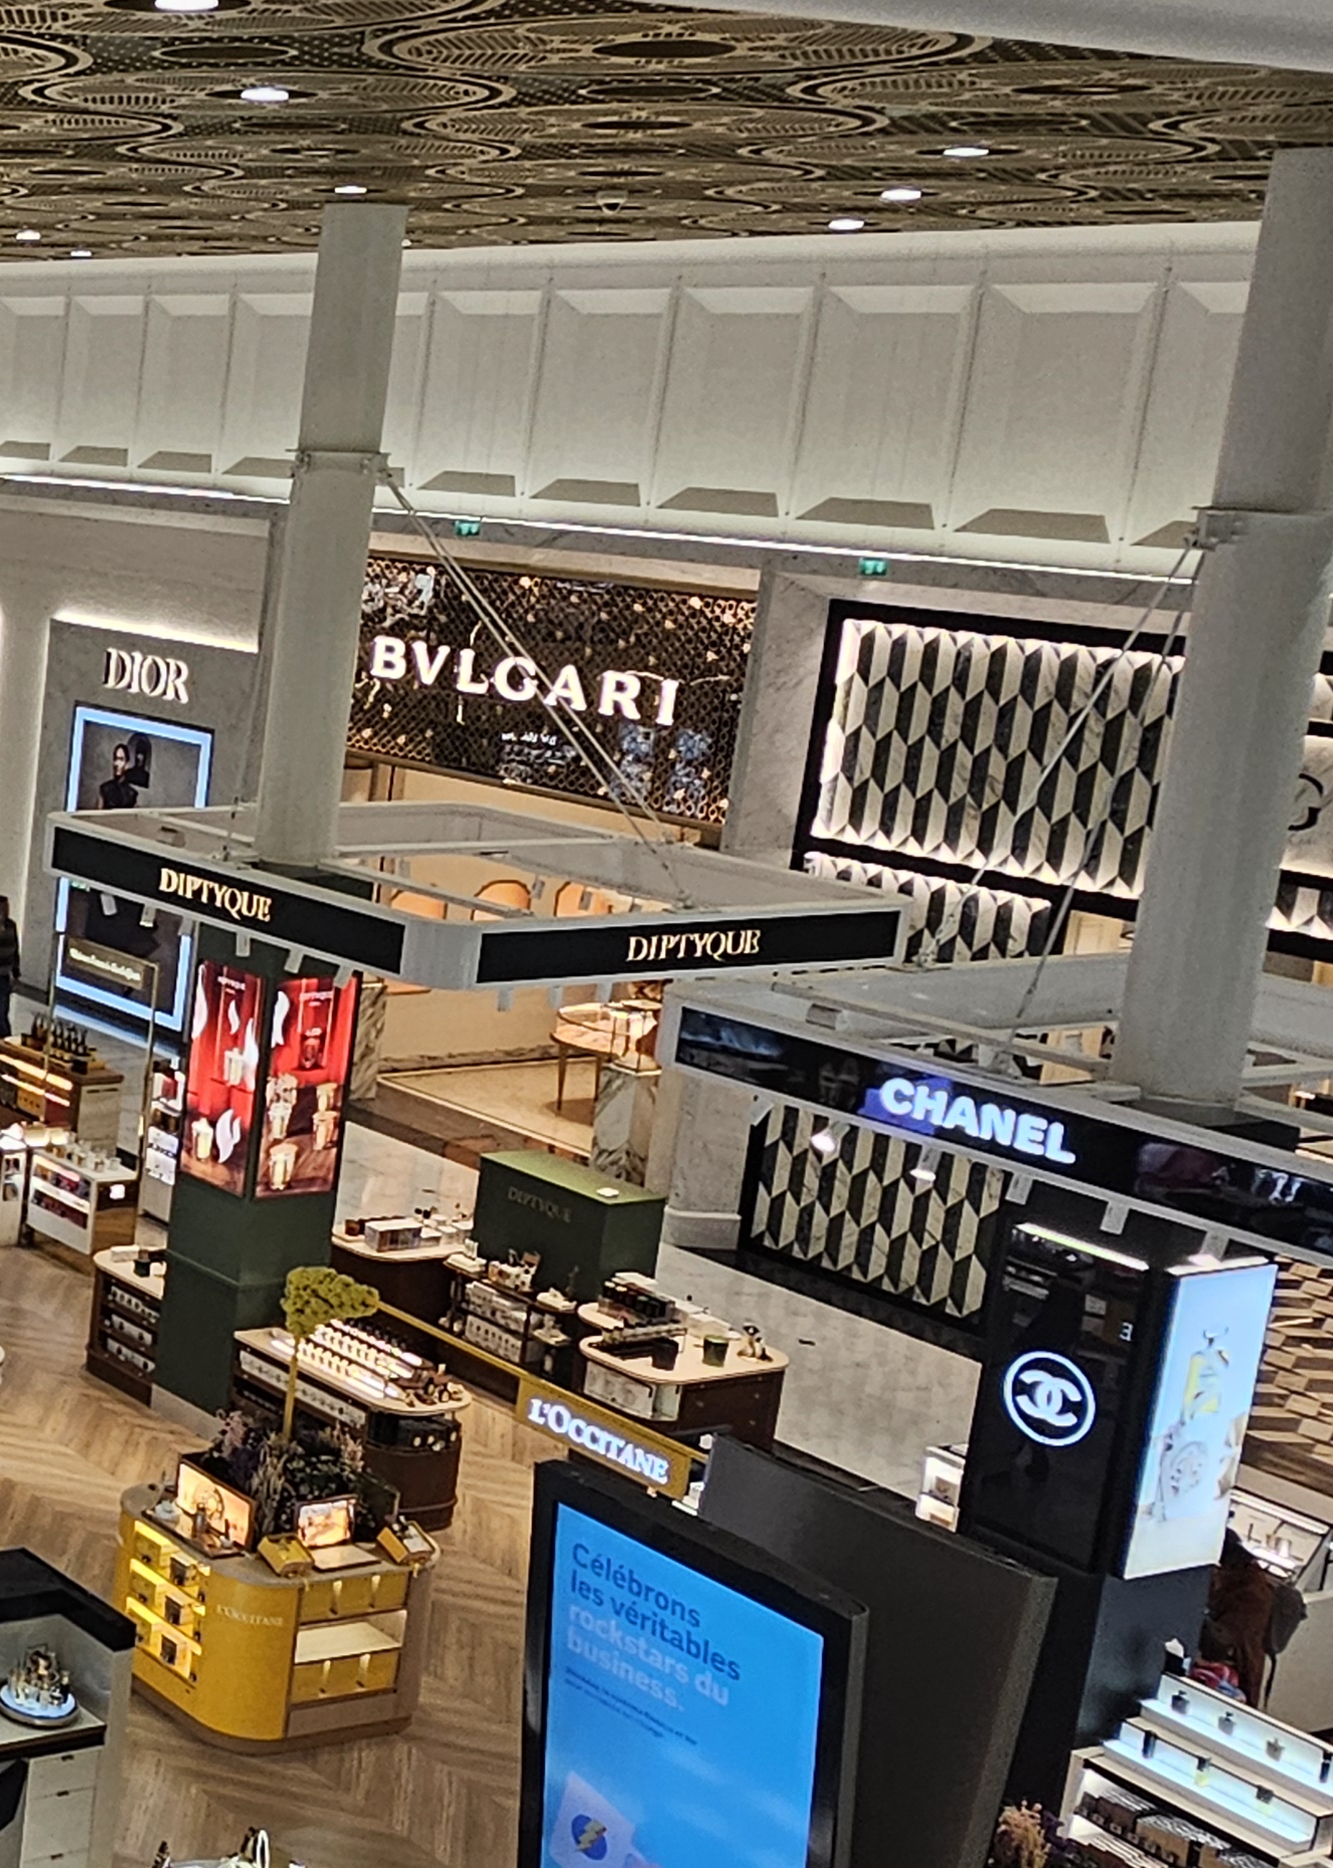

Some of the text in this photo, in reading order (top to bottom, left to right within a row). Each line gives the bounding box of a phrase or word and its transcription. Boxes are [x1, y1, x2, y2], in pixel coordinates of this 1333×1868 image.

[102, 647, 189, 704] DIOR
[369, 634, 679, 726] BVLGARI
[158, 867, 273, 922] DIPTYQUE
[625, 929, 762, 962] DIPTYQUE
[879, 1077, 1077, 1165] CHANEL
[507, 1185, 571, 1224] DIPTYQUE
[527, 1398, 670, 1485] L'OCCITANE
[570, 1568, 741, 1682] les véritables
[571, 1542, 702, 1629] Célébrons
[566, 1625, 686, 1713] business.
[568, 1603, 690, 1685] rockstars
[694, 1669, 730, 1706] du
